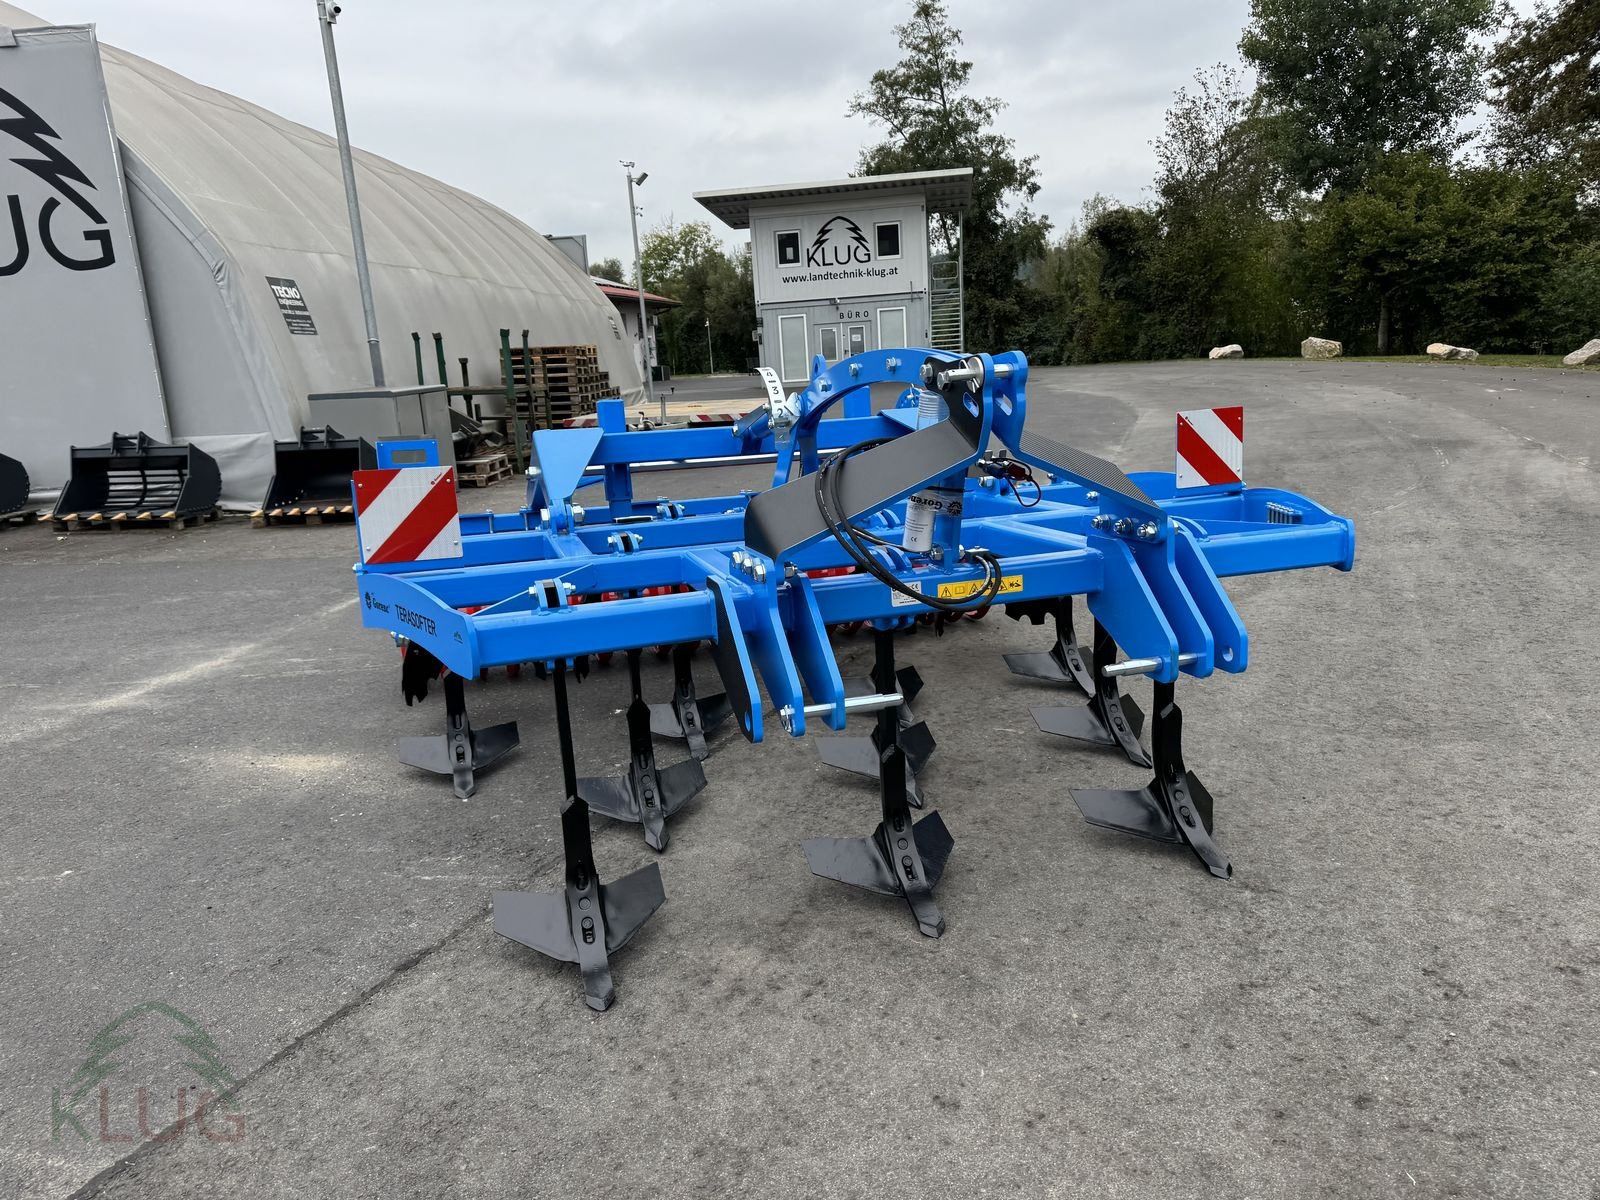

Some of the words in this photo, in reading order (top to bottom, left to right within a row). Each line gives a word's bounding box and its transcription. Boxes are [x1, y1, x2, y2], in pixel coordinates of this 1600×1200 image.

[806, 245, 871, 268] KLUG
[782, 266, 898, 284] www.landtechnik-klug.at
[271, 285, 301, 300] TECNO
[839, 310, 869, 320] BÜRO
[771, 386, 780, 395] 3
[908, 495, 943, 511] Goren
[394, 604, 438, 638] TERASOFTER
